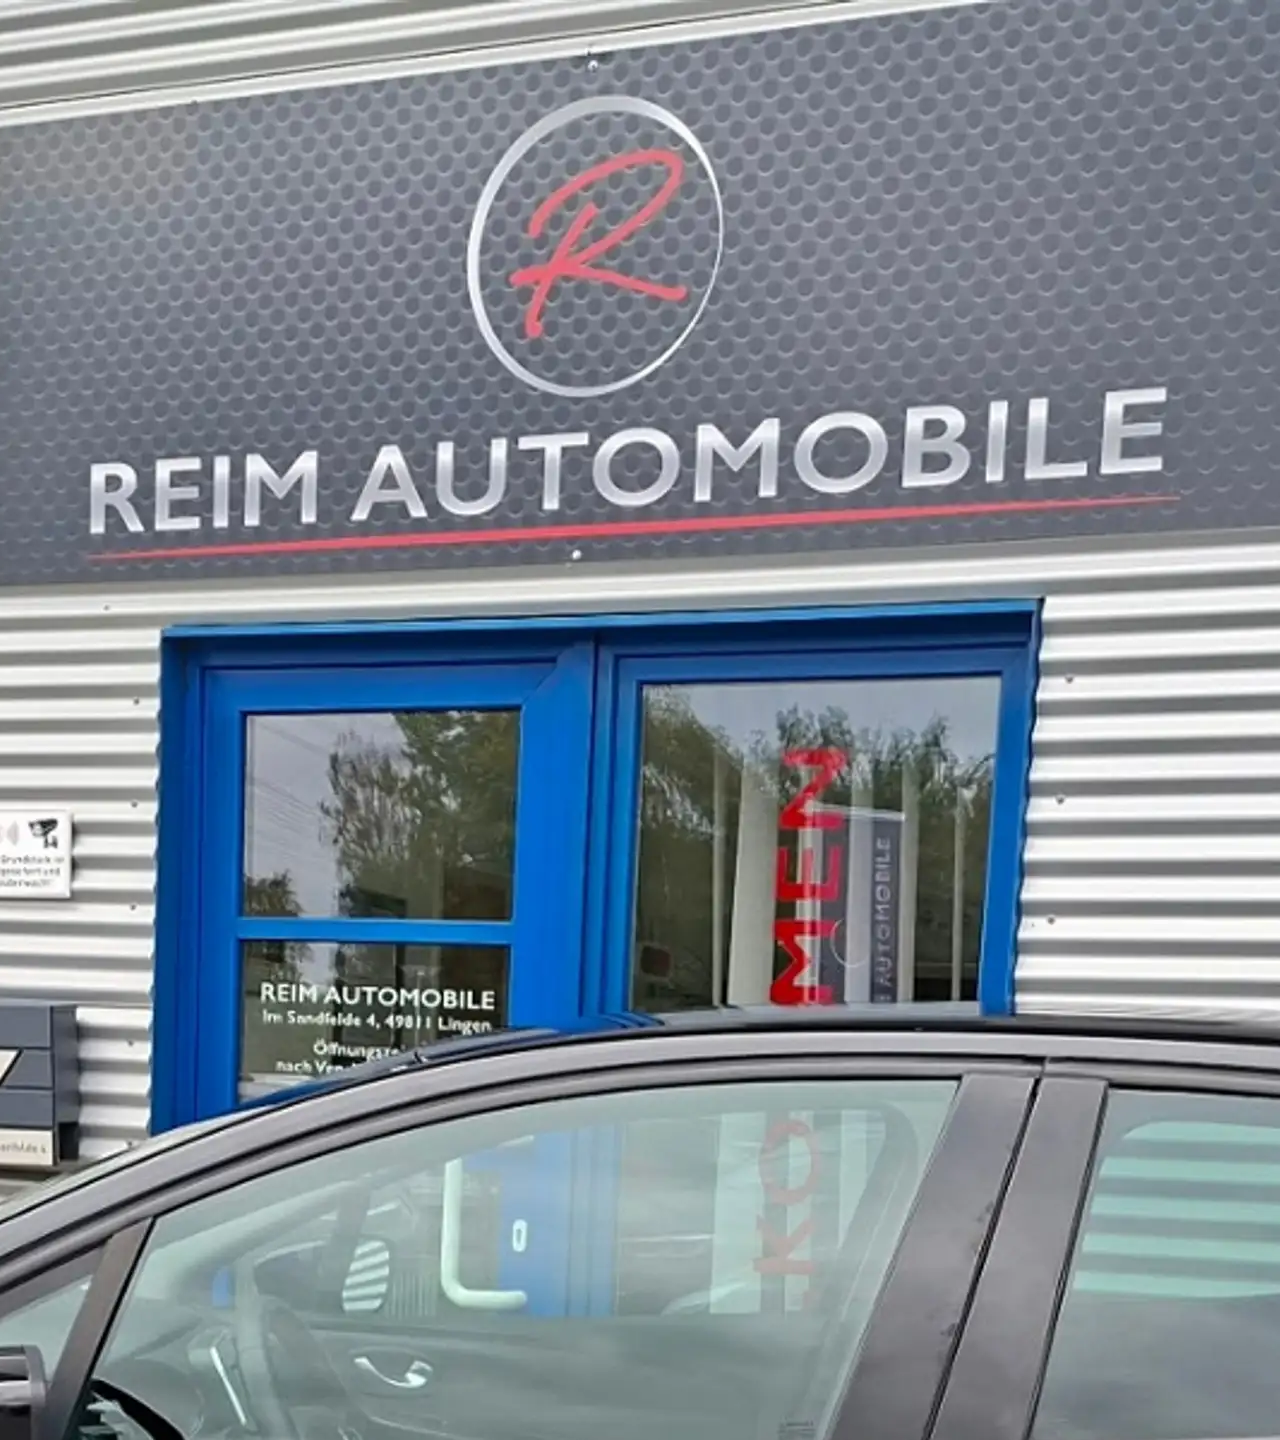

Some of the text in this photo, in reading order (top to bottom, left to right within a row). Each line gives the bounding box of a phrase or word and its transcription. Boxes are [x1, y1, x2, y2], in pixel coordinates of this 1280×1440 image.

[86, 385, 1169, 537] REIM AUTOMOBILE
[260, 983, 496, 1010] REIM AUTOMOBILE
[438, 1018, 492, 1035] Lingen
